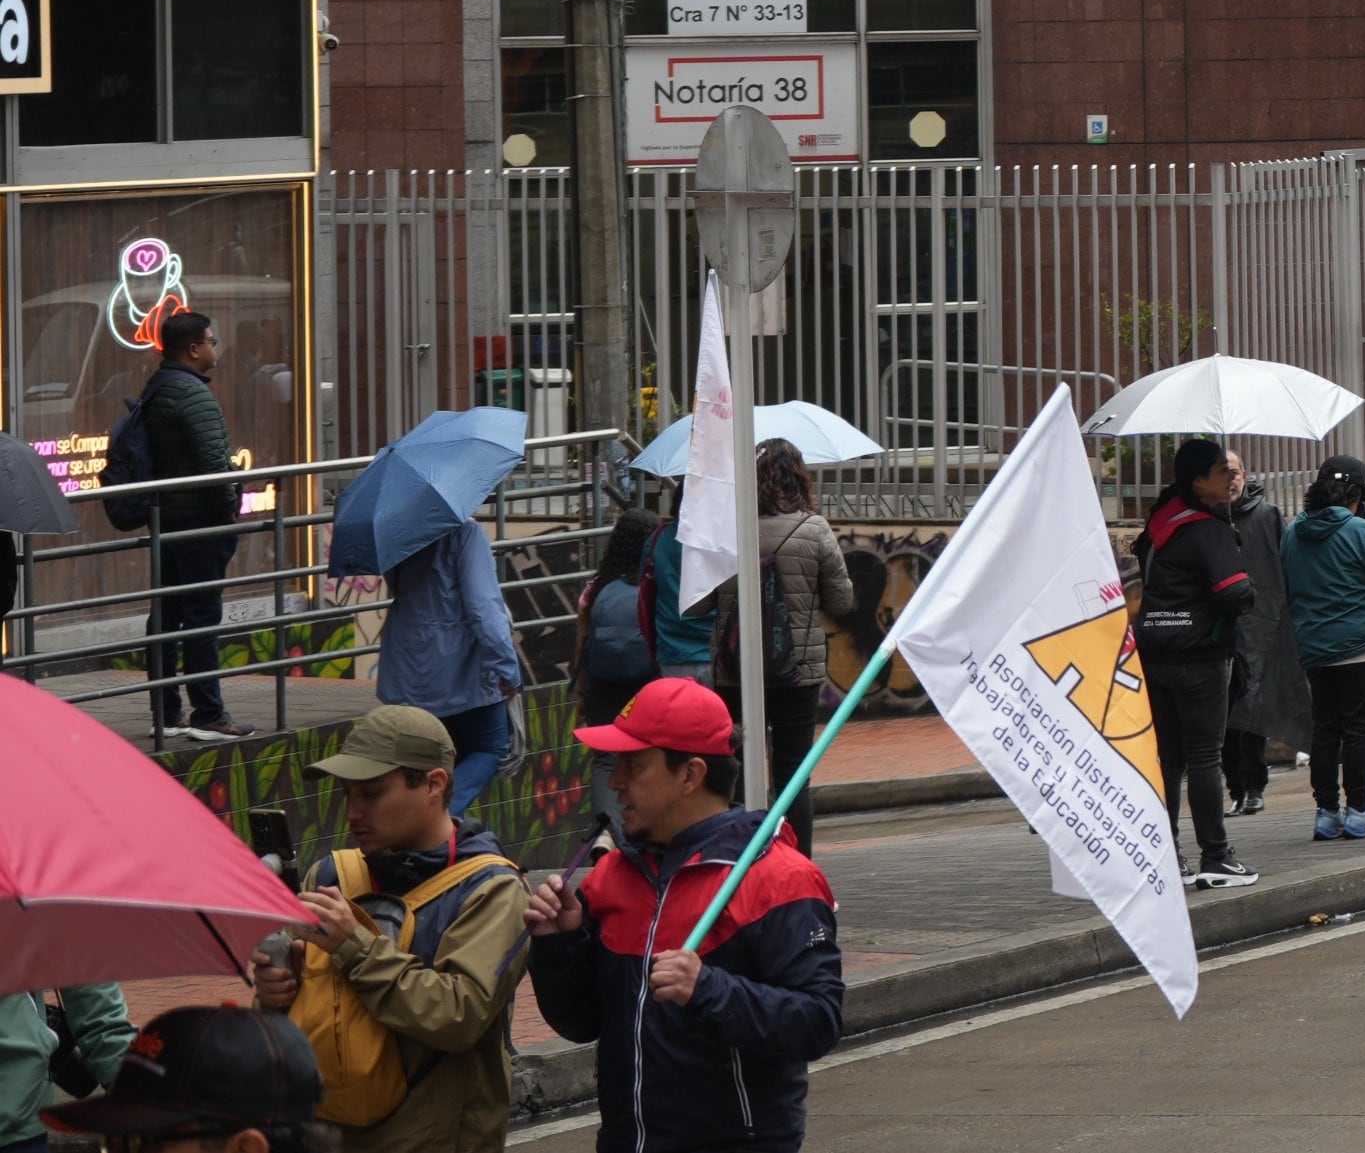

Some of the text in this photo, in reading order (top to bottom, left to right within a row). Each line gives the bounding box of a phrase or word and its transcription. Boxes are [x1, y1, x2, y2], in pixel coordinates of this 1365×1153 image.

[670, 4, 804, 22] Cra 7 N° 33-13
[655, 77, 808, 103] Notaría 38
[798, 134, 817, 147] SNR
[988, 654, 1162, 849] Asociación Distrital de
[992, 725, 1110, 866] de la Educación
[1055, 766, 1068, 784] y
[1071, 772, 1166, 895] Trabajadoras
